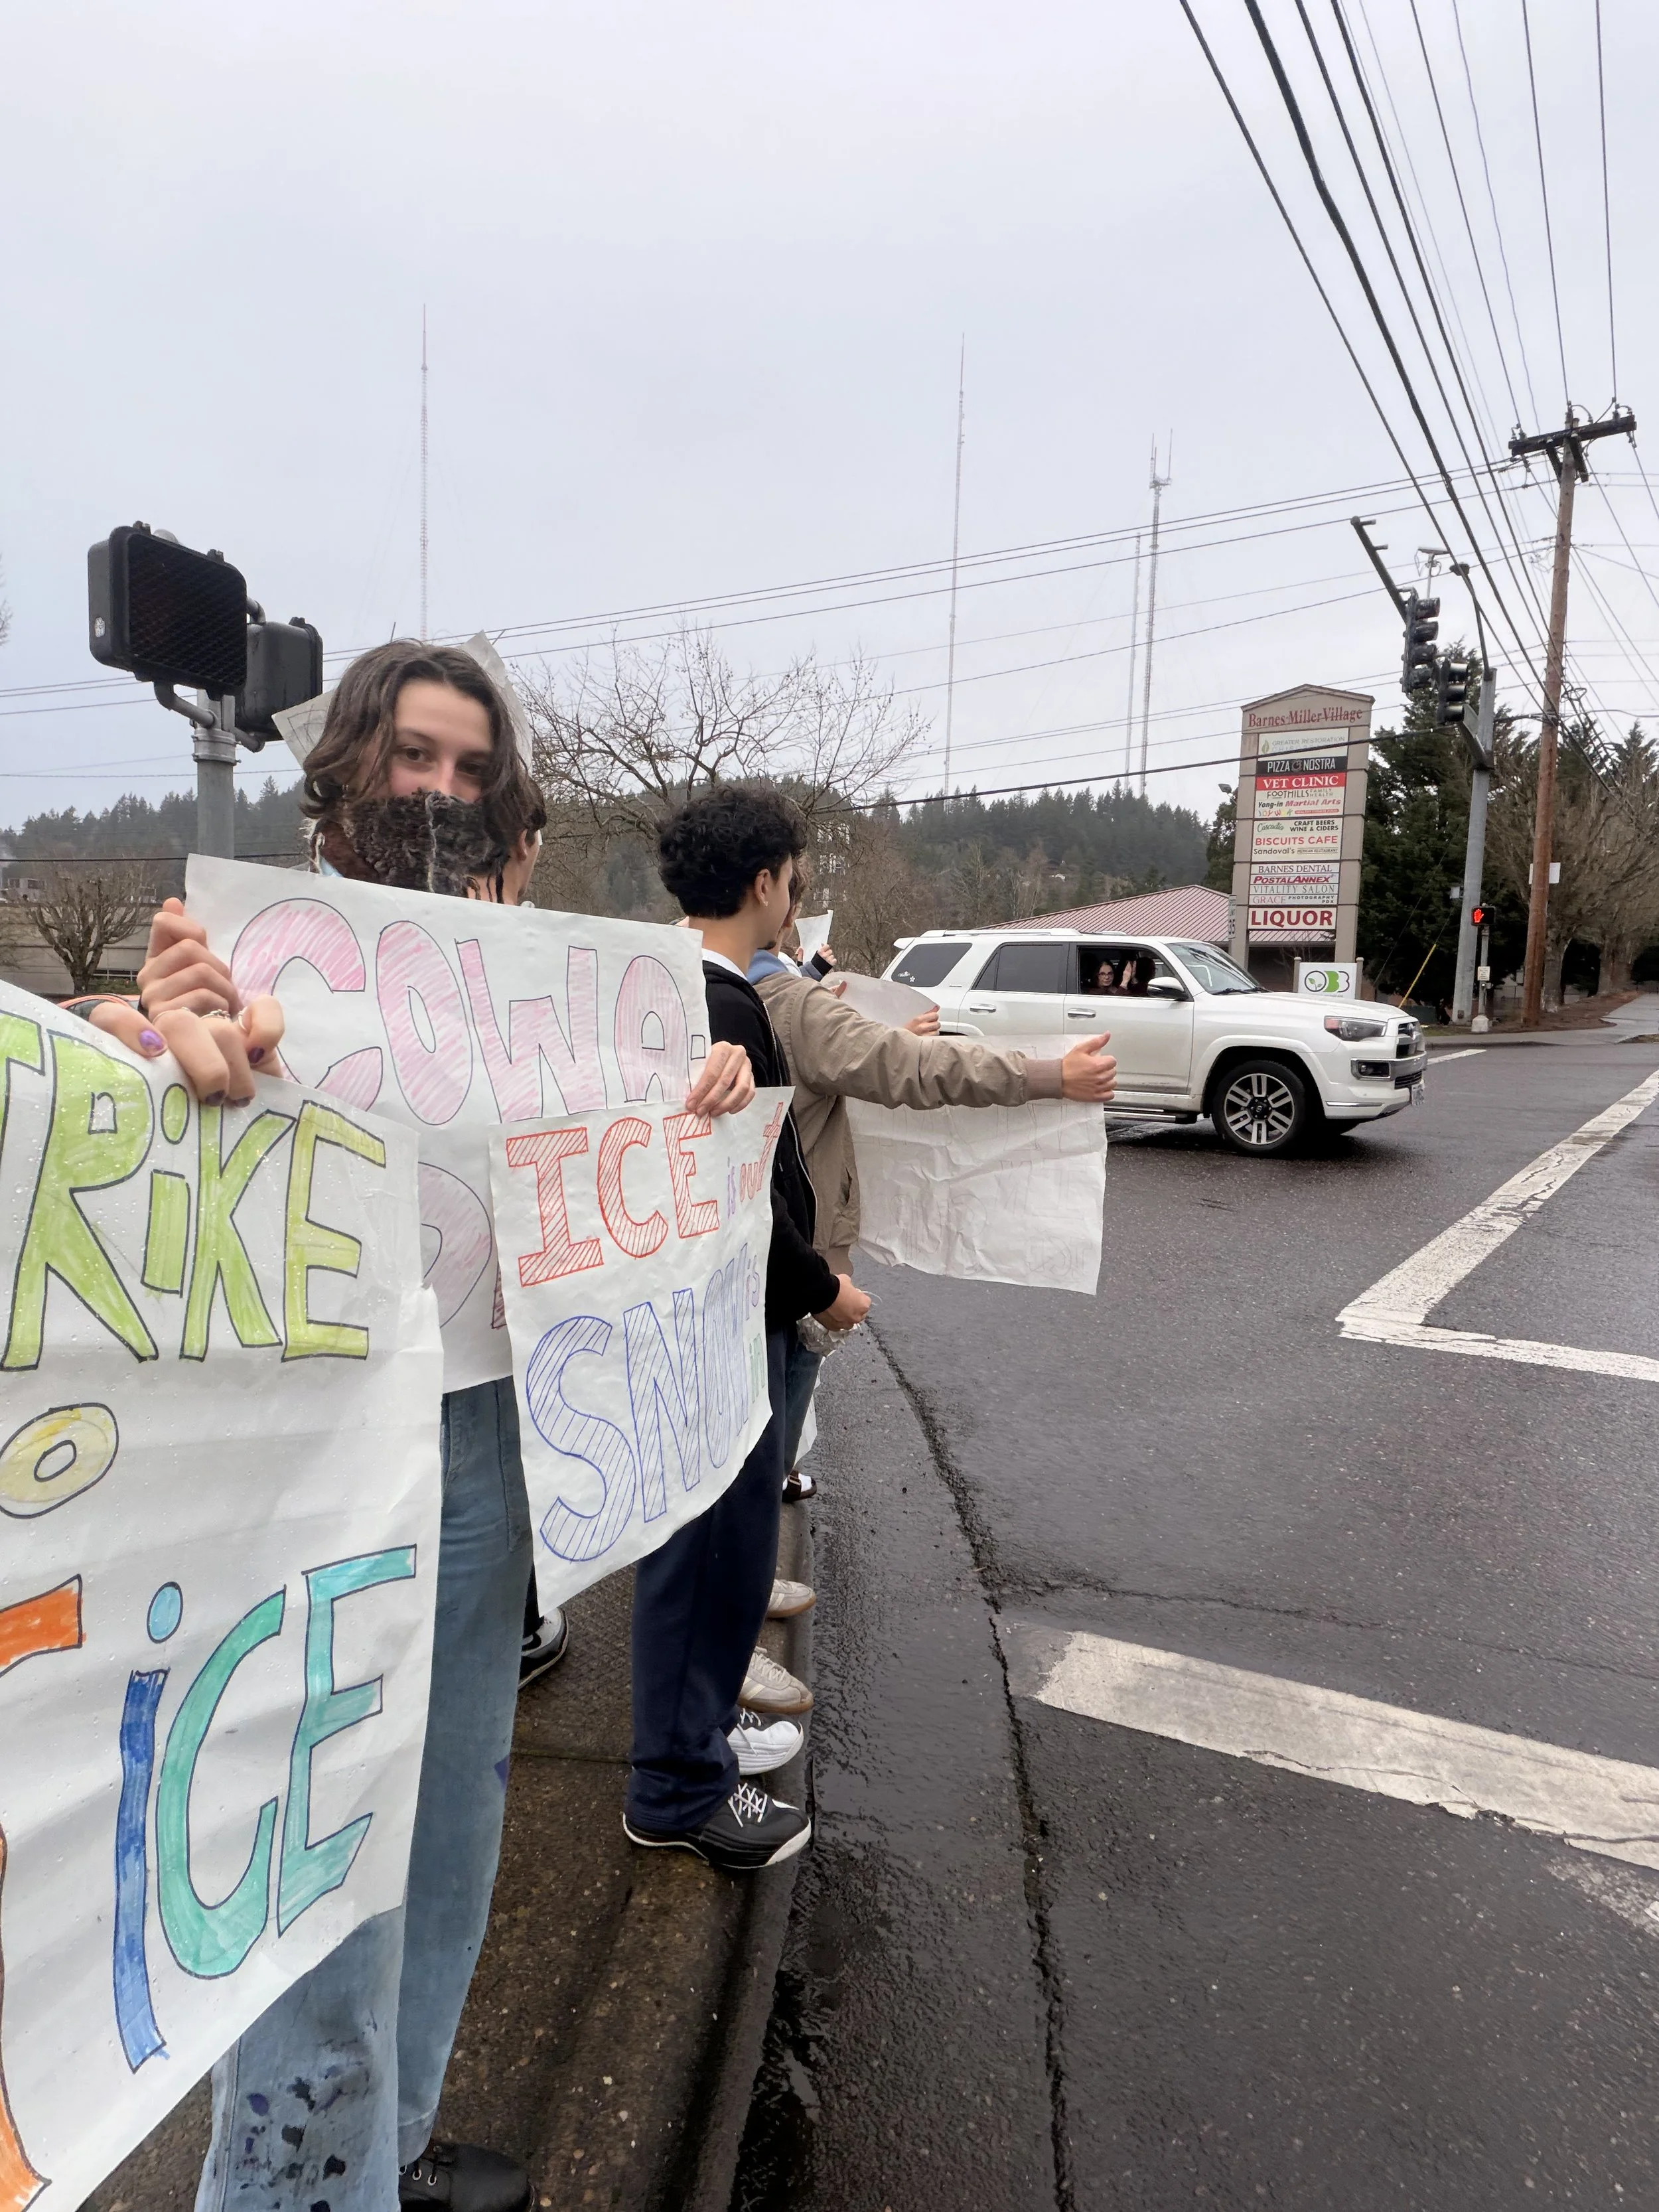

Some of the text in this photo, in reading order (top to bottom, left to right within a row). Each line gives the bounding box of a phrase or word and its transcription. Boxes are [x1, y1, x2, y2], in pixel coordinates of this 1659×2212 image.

[1323, 706, 1362, 723] Village
[1267, 758, 1335, 773] PIZZA NOSTRA
[1263, 775, 1338, 788] VET CLINIC
[1267, 790, 1309, 798] FOOTHILLS
[1258, 822, 1284, 832] Cascadia
[1256, 836, 1338, 846] BISCUITS CAFE
[1296, 864, 1333, 873] DENTAL
[1303, 885, 1335, 893] SALON
[1251, 910, 1333, 928] LIQUOR
[506, 1111, 720, 1288] ICE
[526, 1242, 749, 1562] SNOW
